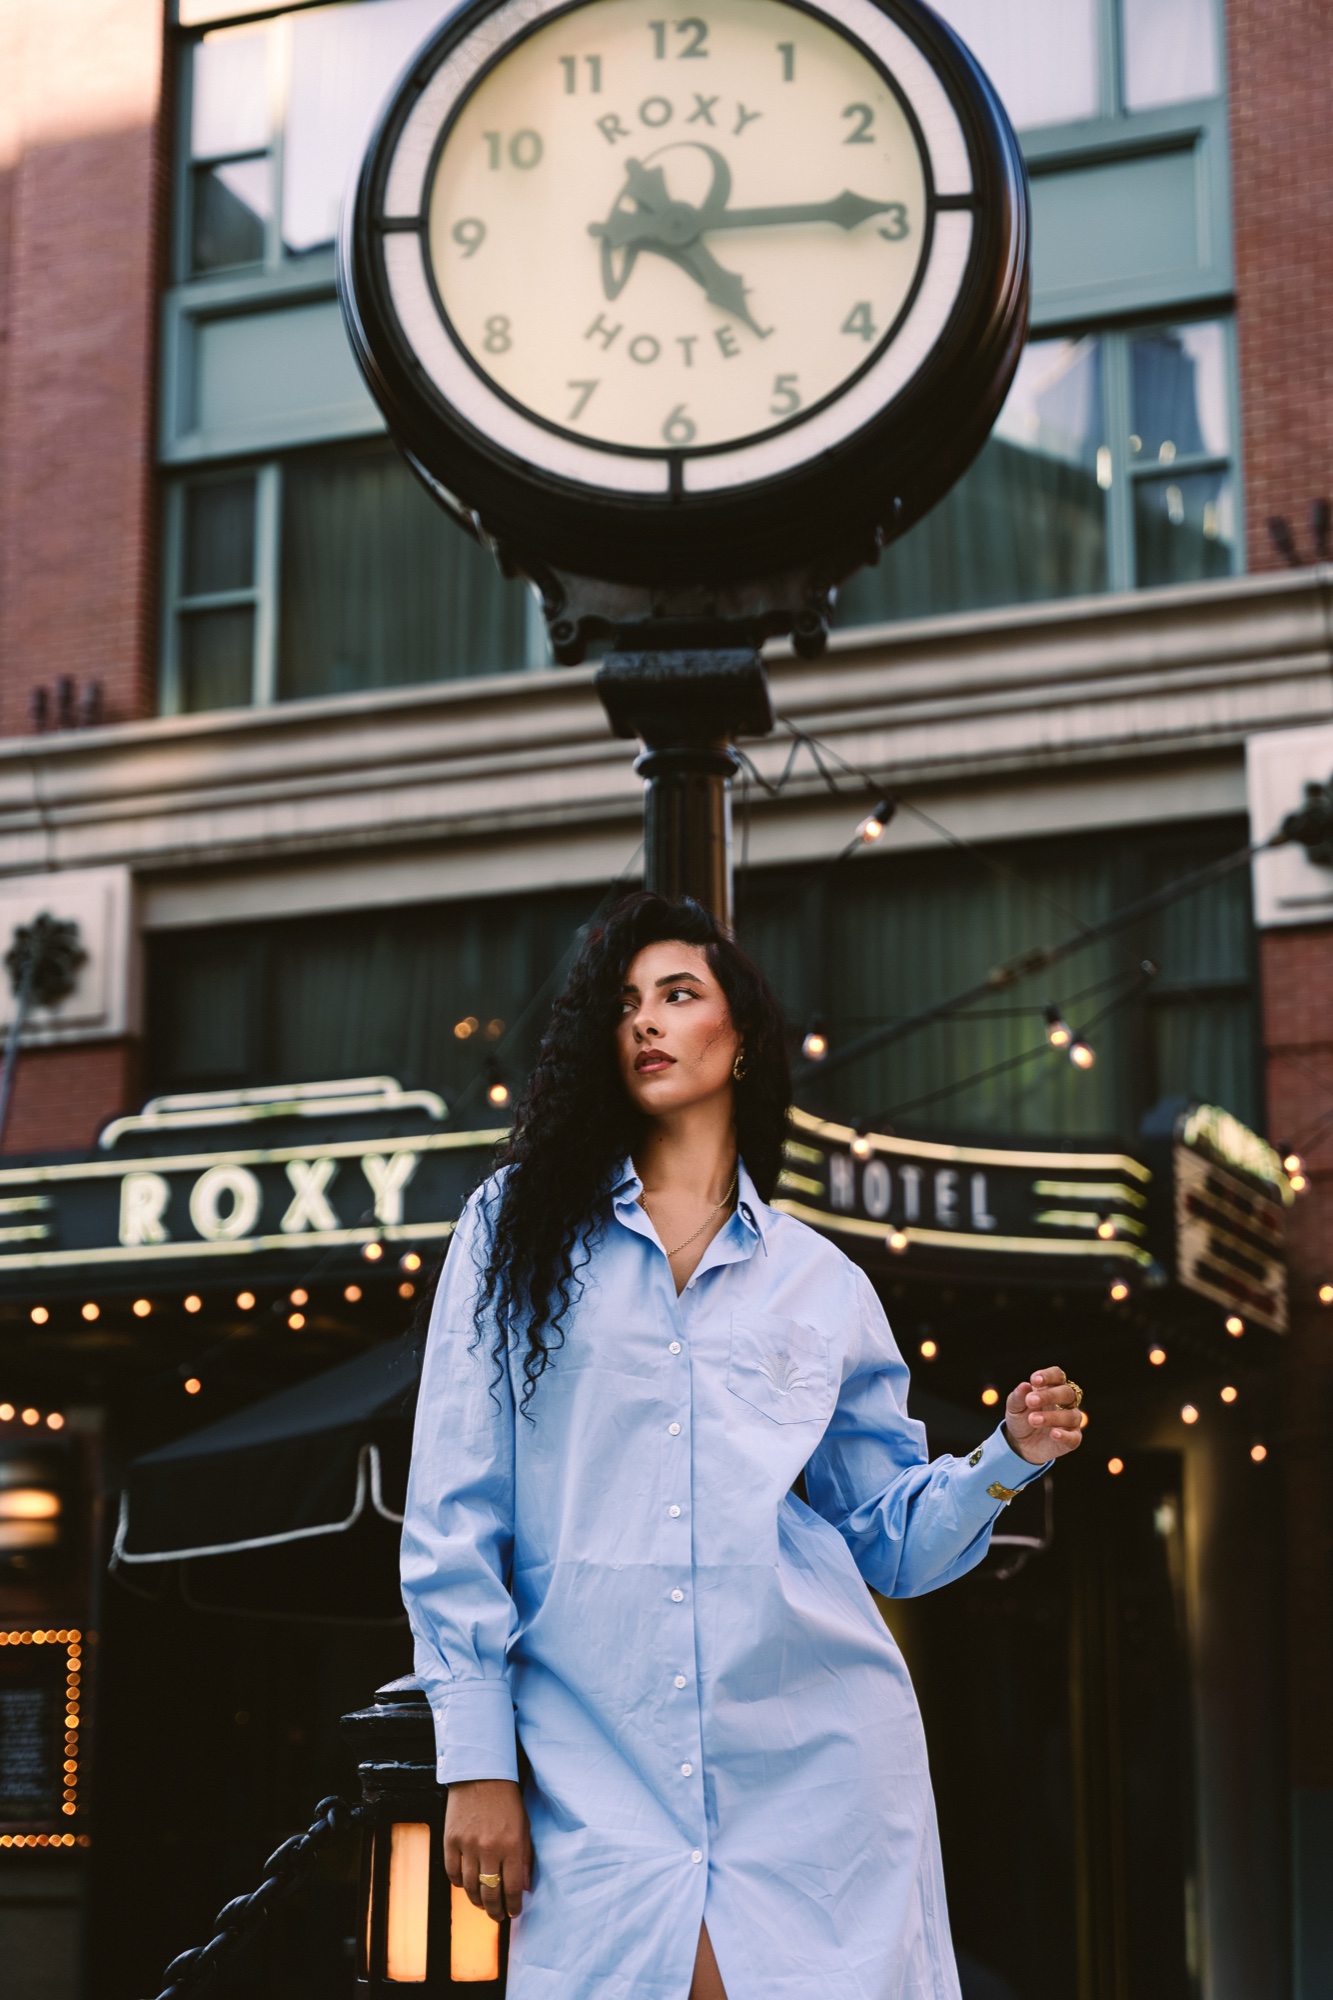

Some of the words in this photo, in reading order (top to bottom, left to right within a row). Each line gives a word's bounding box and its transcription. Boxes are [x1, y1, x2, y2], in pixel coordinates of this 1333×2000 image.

[646, 18, 709, 60] 12
[559, 54, 602, 95] 11
[776, 42, 796, 83] 1
[596, 93, 764, 146] ROXY
[842, 103, 876, 145] 2
[482, 129, 544, 171] 10
[451, 217, 488, 259] 9
[878, 202, 910, 242] 3
[482, 314, 513, 355] 8
[583, 312, 776, 369] HOTEL
[840, 301, 877, 343] 4
[566, 378, 601, 421] 7
[768, 373, 802, 417] 5
[660, 402, 697, 448] 6
[118, 1150, 420, 1247] ROXY
[829, 1152, 997, 1231] HOTEL
